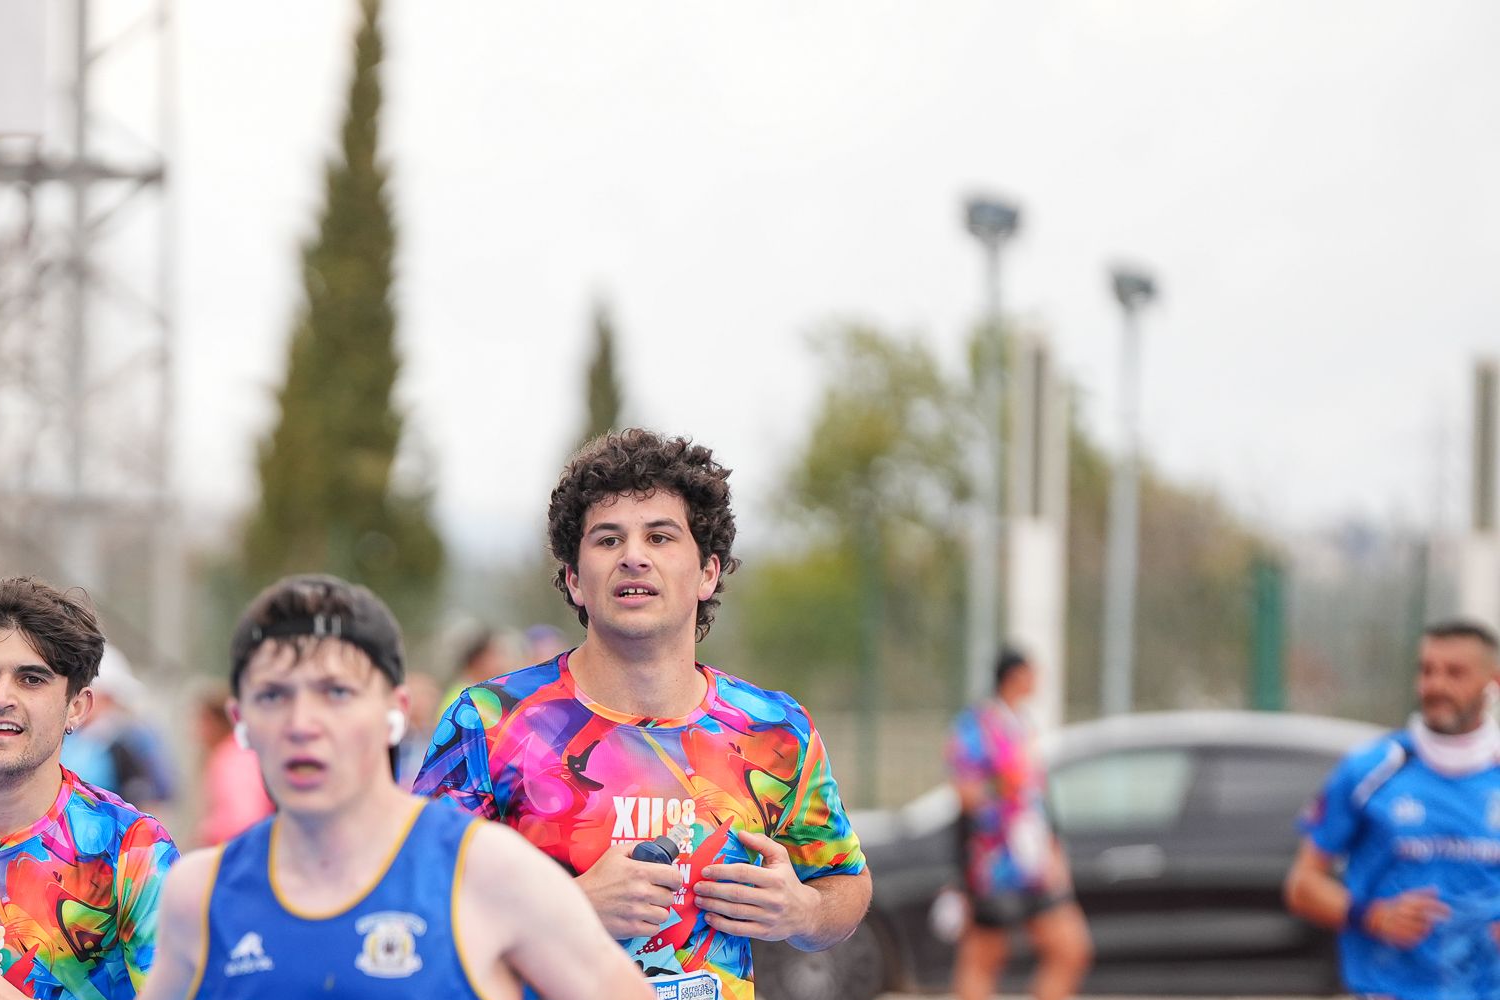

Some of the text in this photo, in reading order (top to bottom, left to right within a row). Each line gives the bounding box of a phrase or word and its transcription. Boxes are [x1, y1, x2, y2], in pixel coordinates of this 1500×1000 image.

[611, 796, 664, 839] XII
[666, 798, 696, 826] 08
[681, 983, 709, 994] carreras
[681, 988, 714, 1000] populares
